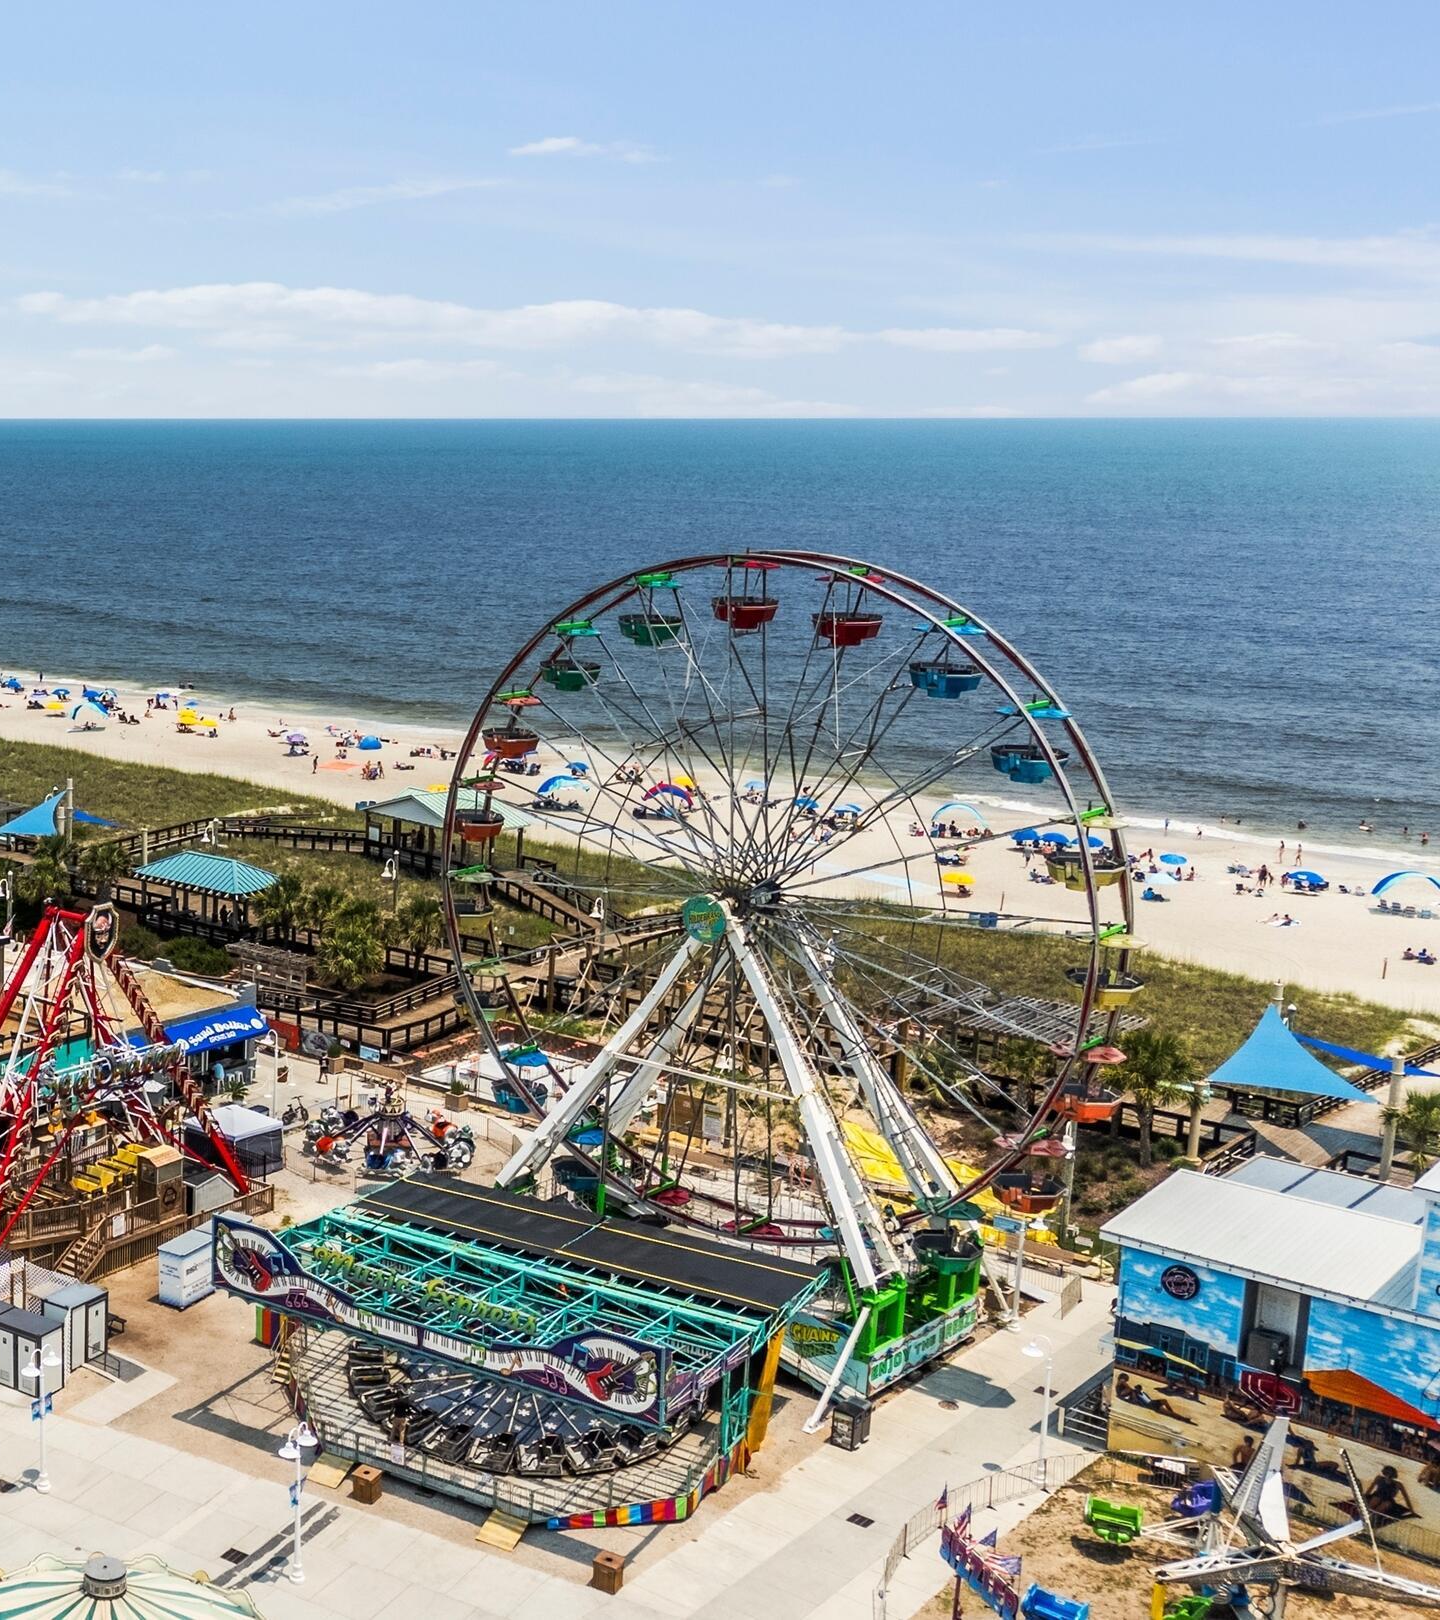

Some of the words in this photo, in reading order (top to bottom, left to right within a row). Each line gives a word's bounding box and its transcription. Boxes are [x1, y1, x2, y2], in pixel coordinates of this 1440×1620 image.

[188, 1025, 215, 1046] Sand
[212, 1020, 252, 1034] Dollar
[314, 1247, 411, 1296] Music
[420, 1279, 538, 1336] Express
[791, 1321, 839, 1343] GIANT
[870, 1349, 910, 1382] ENJOY
